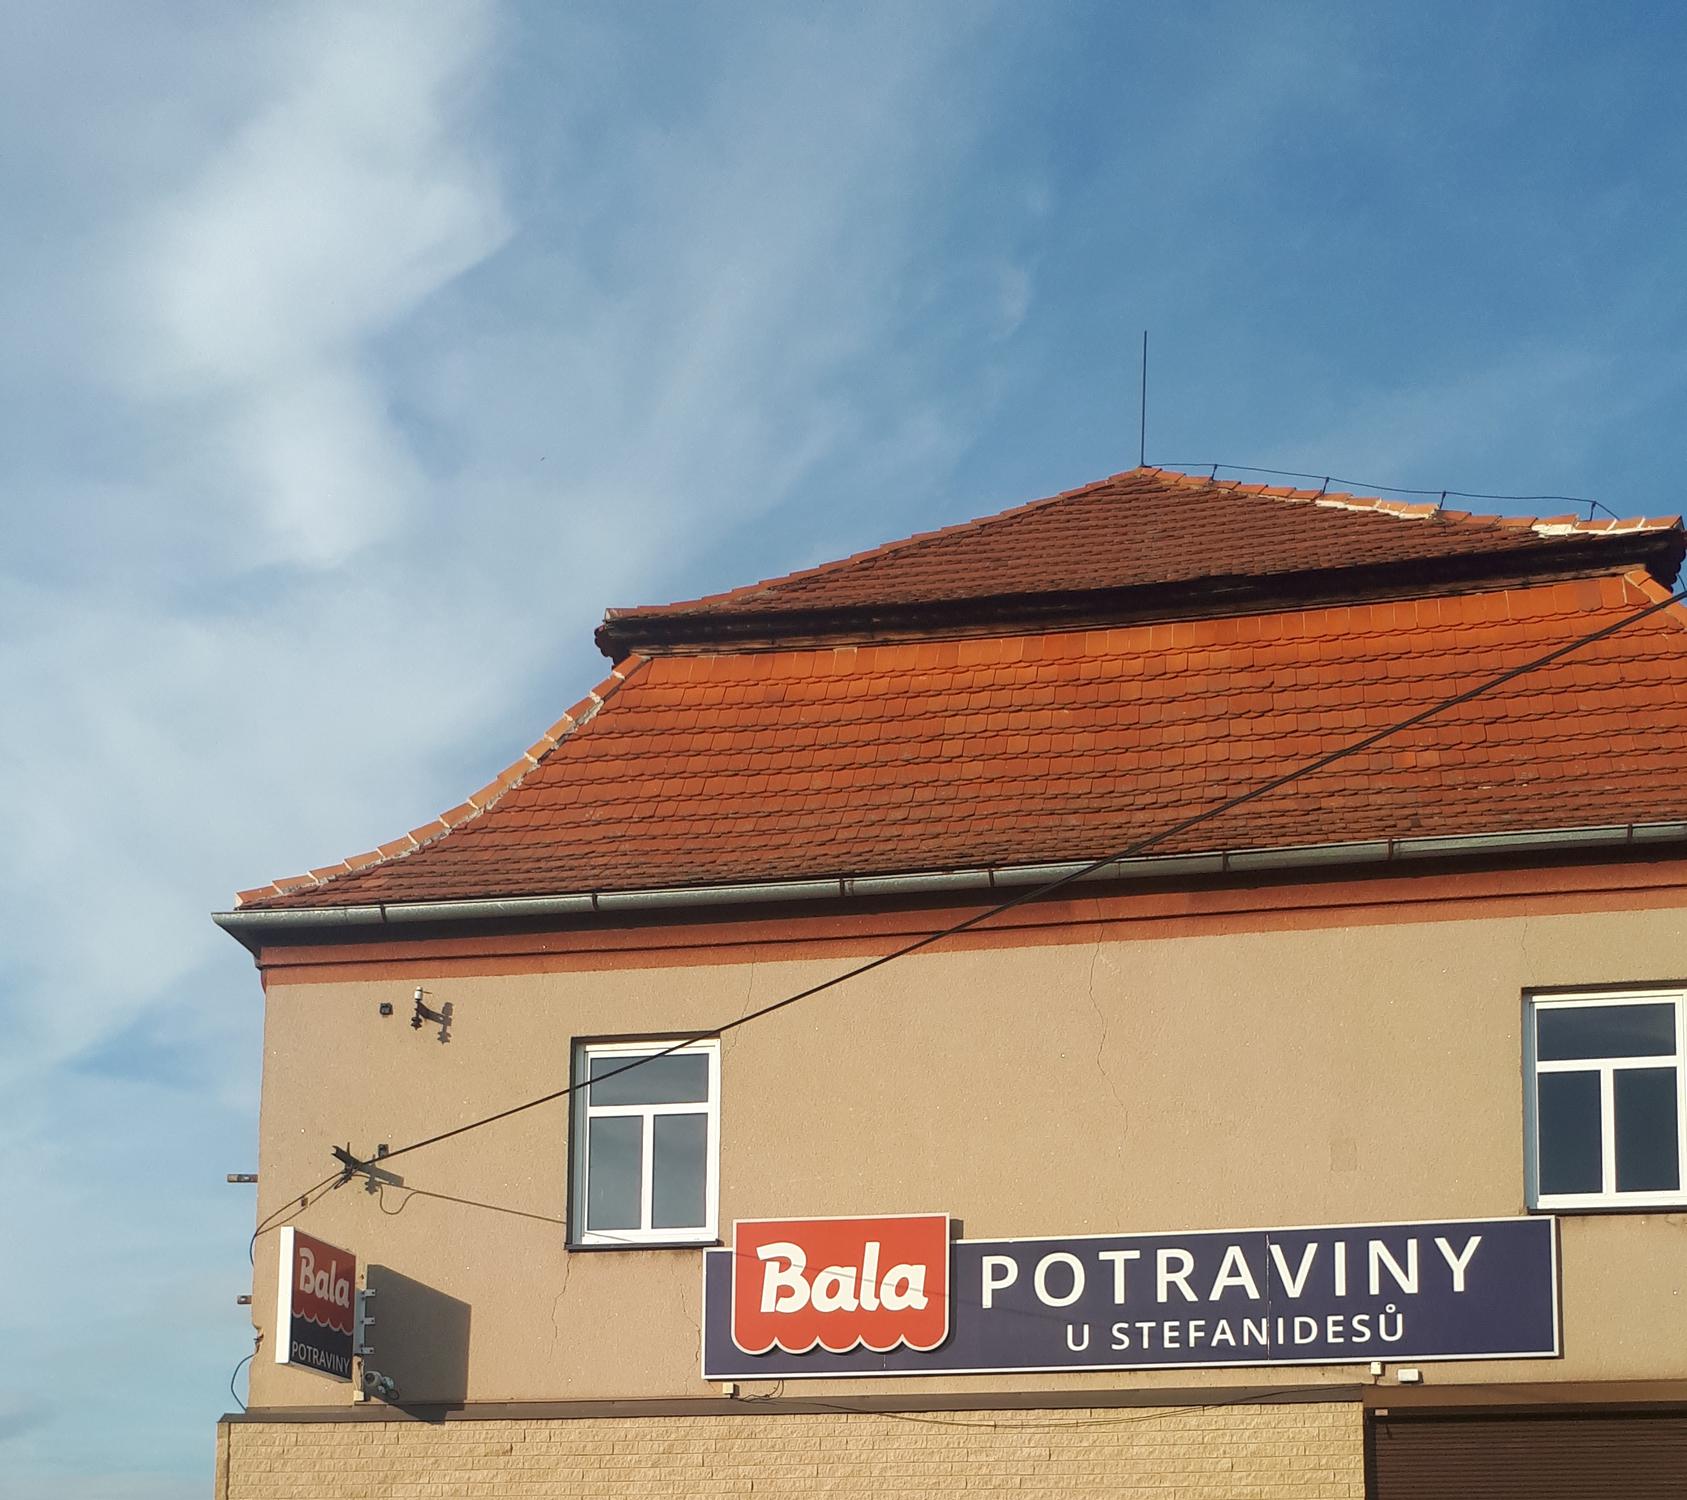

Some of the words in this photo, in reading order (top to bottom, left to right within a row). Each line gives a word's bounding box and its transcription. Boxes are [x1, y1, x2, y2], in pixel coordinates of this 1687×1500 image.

[299, 1248, 350, 1308] Bala
[756, 1239, 929, 1314] Bala
[980, 1235, 1482, 1309] POTRAVINY
[292, 1341, 350, 1373] POTRAVINY
[1066, 1325, 1091, 1351] U
[1111, 1303, 1405, 1350] STEFANIDESŮ
